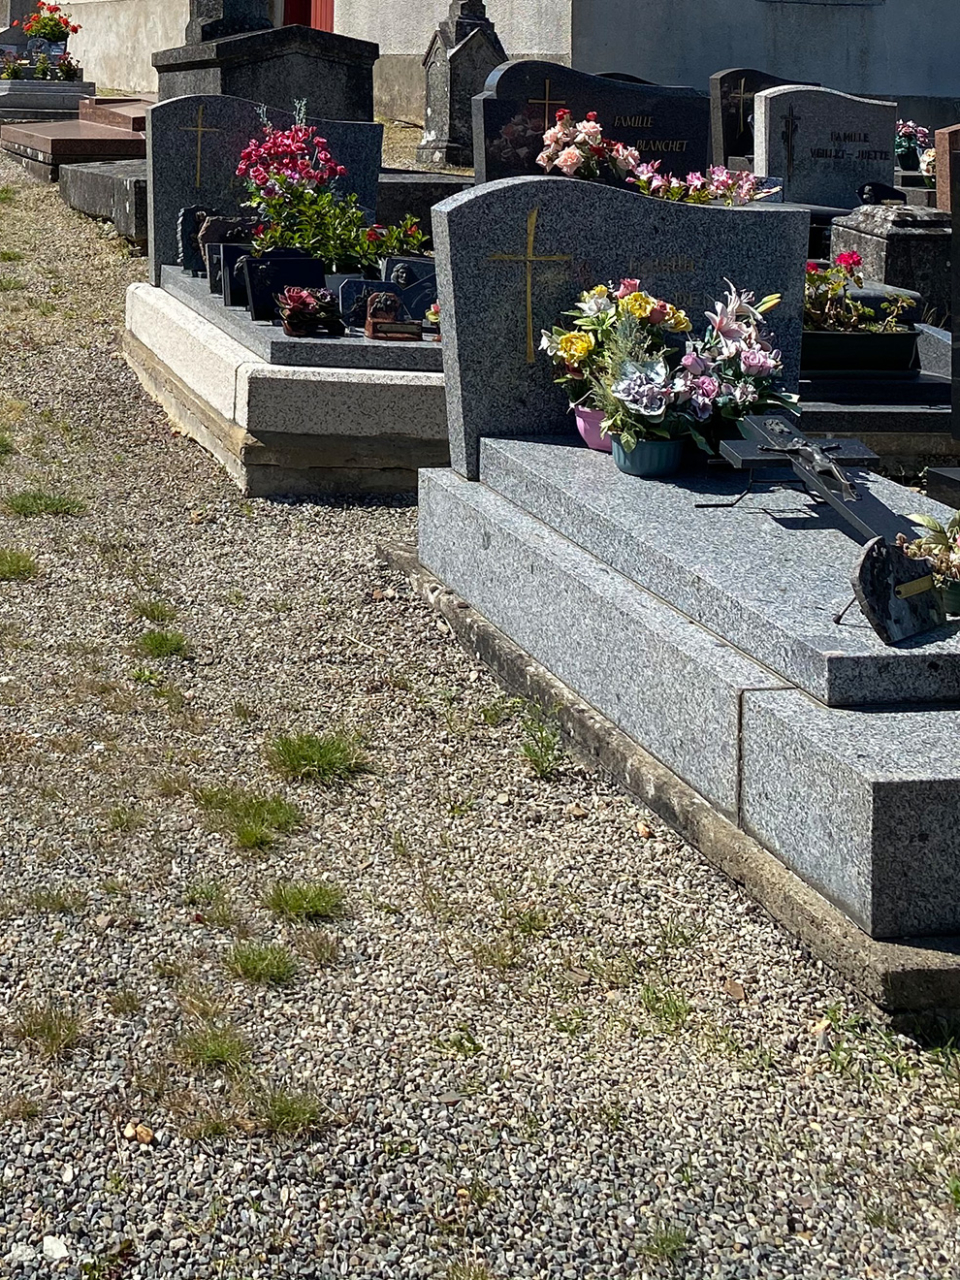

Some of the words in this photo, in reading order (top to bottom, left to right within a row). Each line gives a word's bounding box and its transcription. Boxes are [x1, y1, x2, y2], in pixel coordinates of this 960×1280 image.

[613, 115, 654, 128] FAMILLE
[830, 131, 870, 143] FAMILLE
[636, 139, 688, 152] BLANCHET
